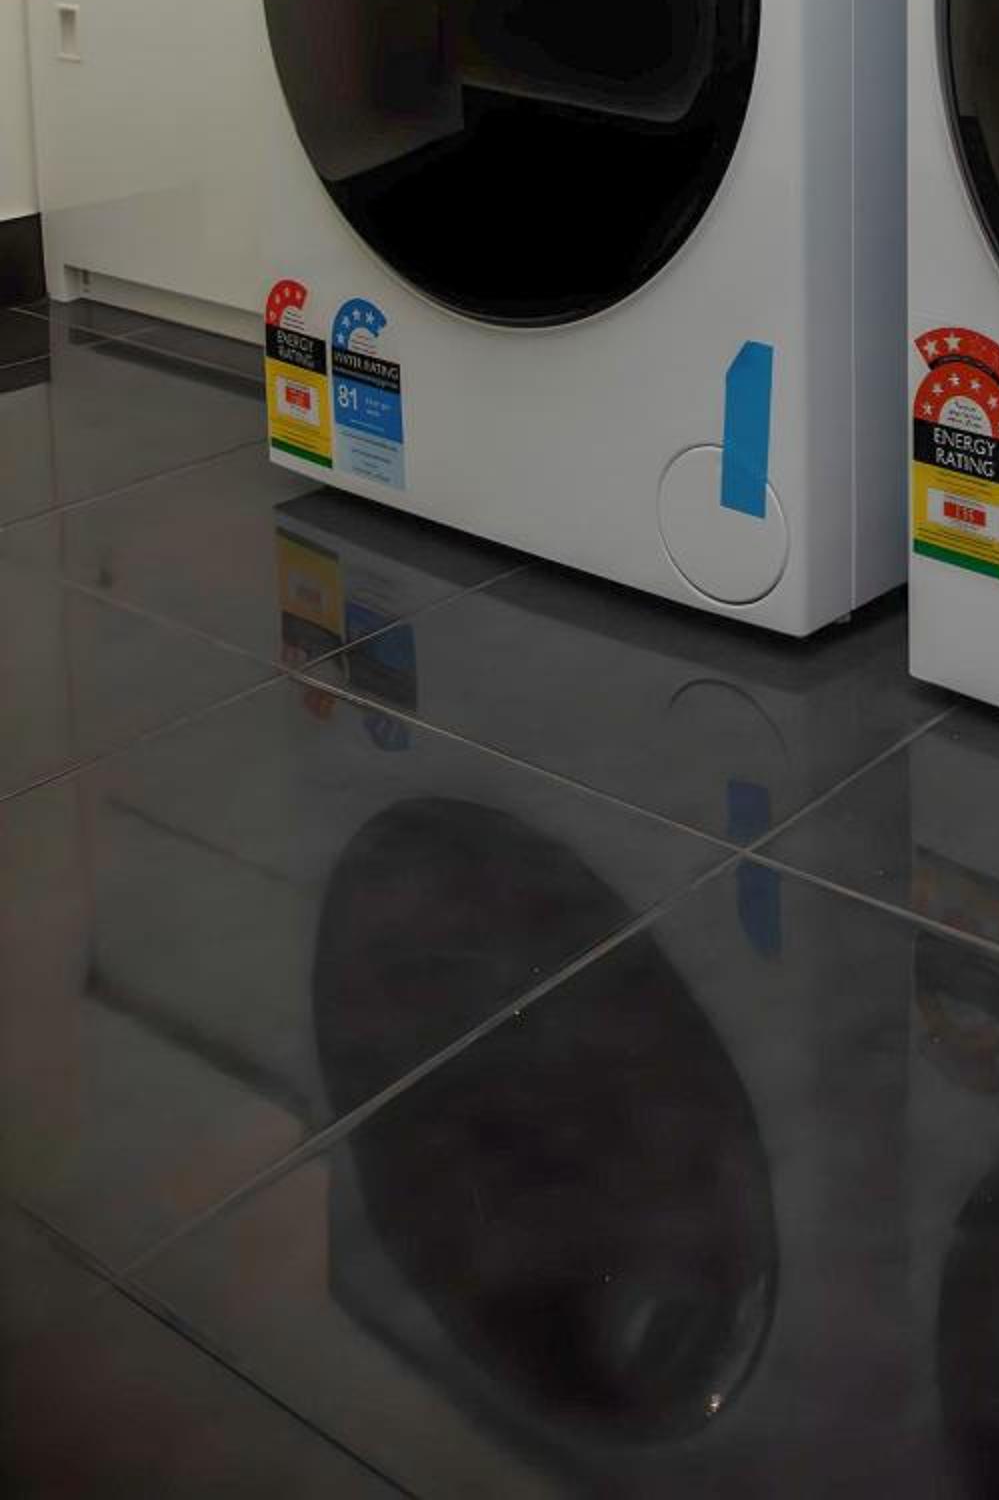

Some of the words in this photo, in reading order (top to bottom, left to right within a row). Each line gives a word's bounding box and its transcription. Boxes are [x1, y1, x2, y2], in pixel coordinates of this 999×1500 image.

[337, 384, 358, 411] 81
[933, 427, 996, 456] ENERGY
[935, 447, 994, 477] RATING
